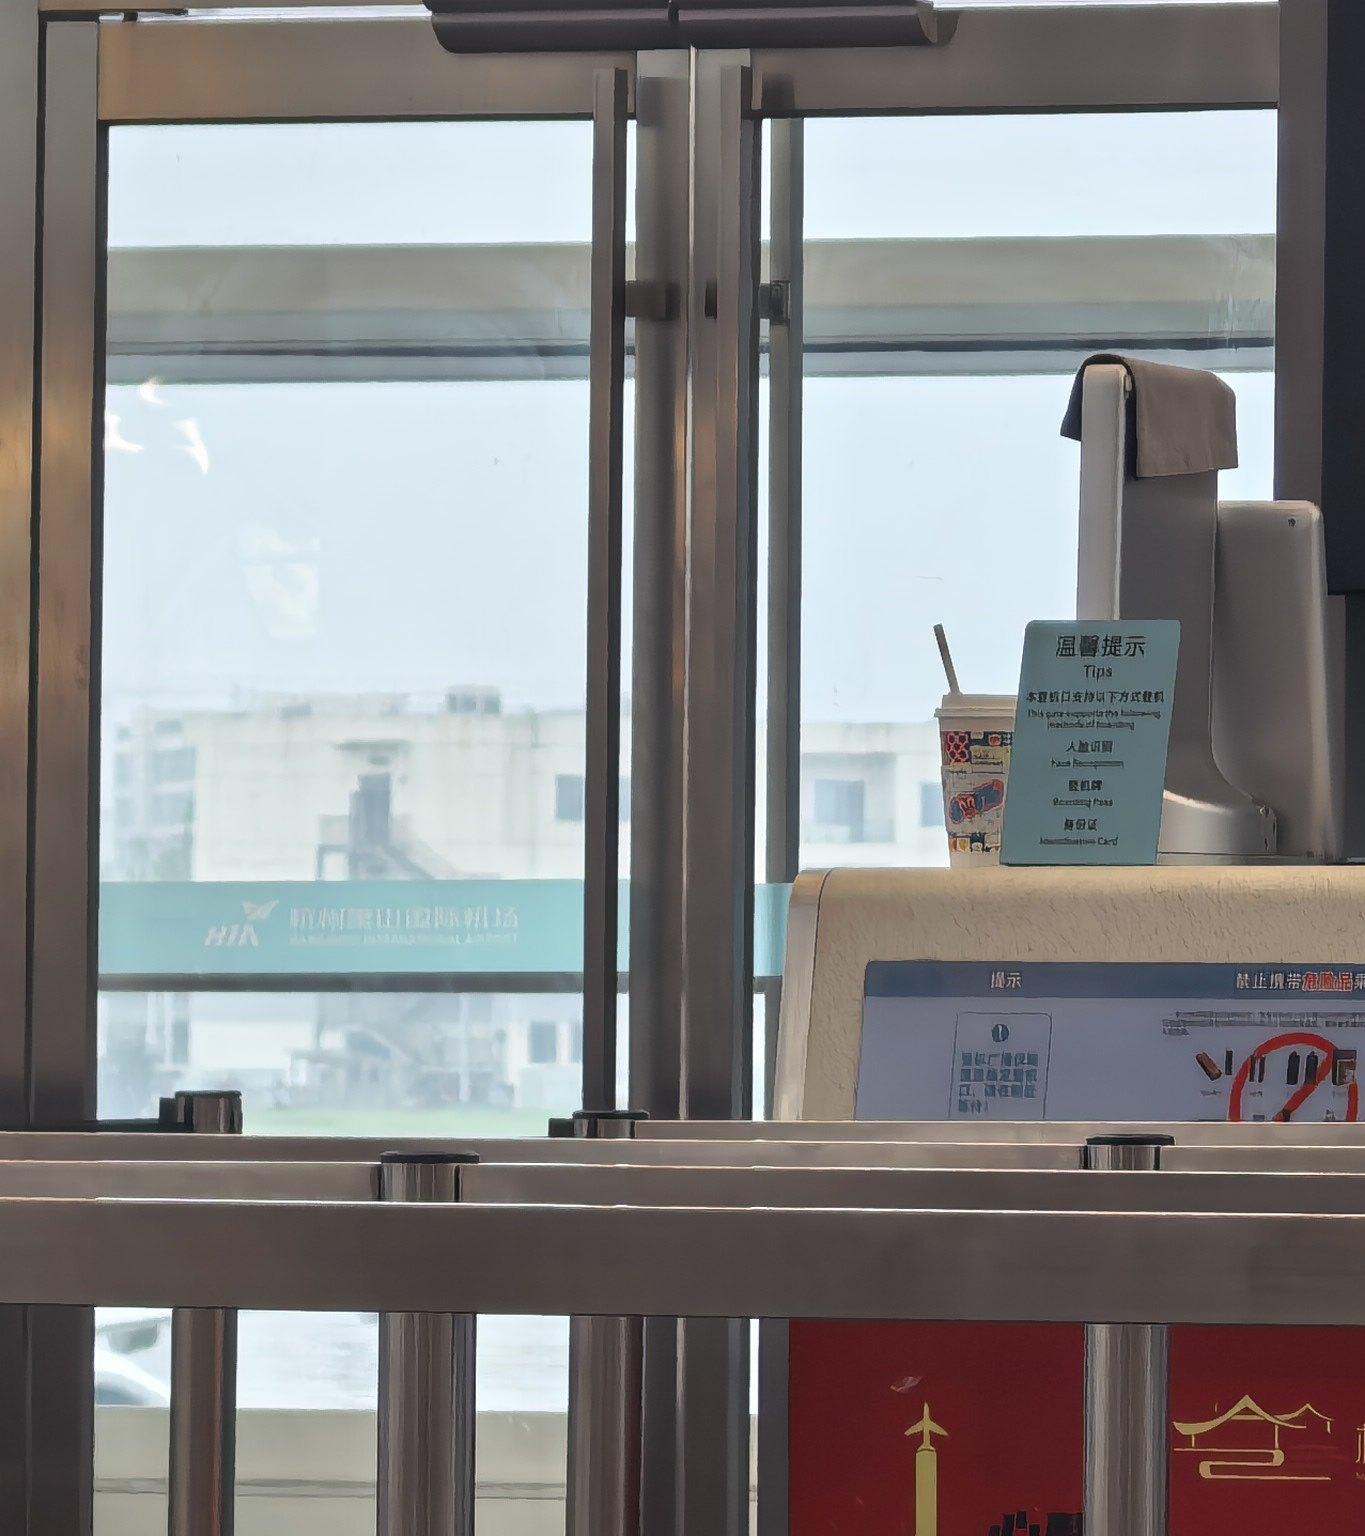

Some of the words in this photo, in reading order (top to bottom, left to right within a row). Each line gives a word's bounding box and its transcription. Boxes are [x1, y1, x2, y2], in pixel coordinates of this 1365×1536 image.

[1056, 635, 1146, 657] 温馨提示
[1084, 665, 1112, 681] Tips
[990, 970, 1022, 989] 提示
